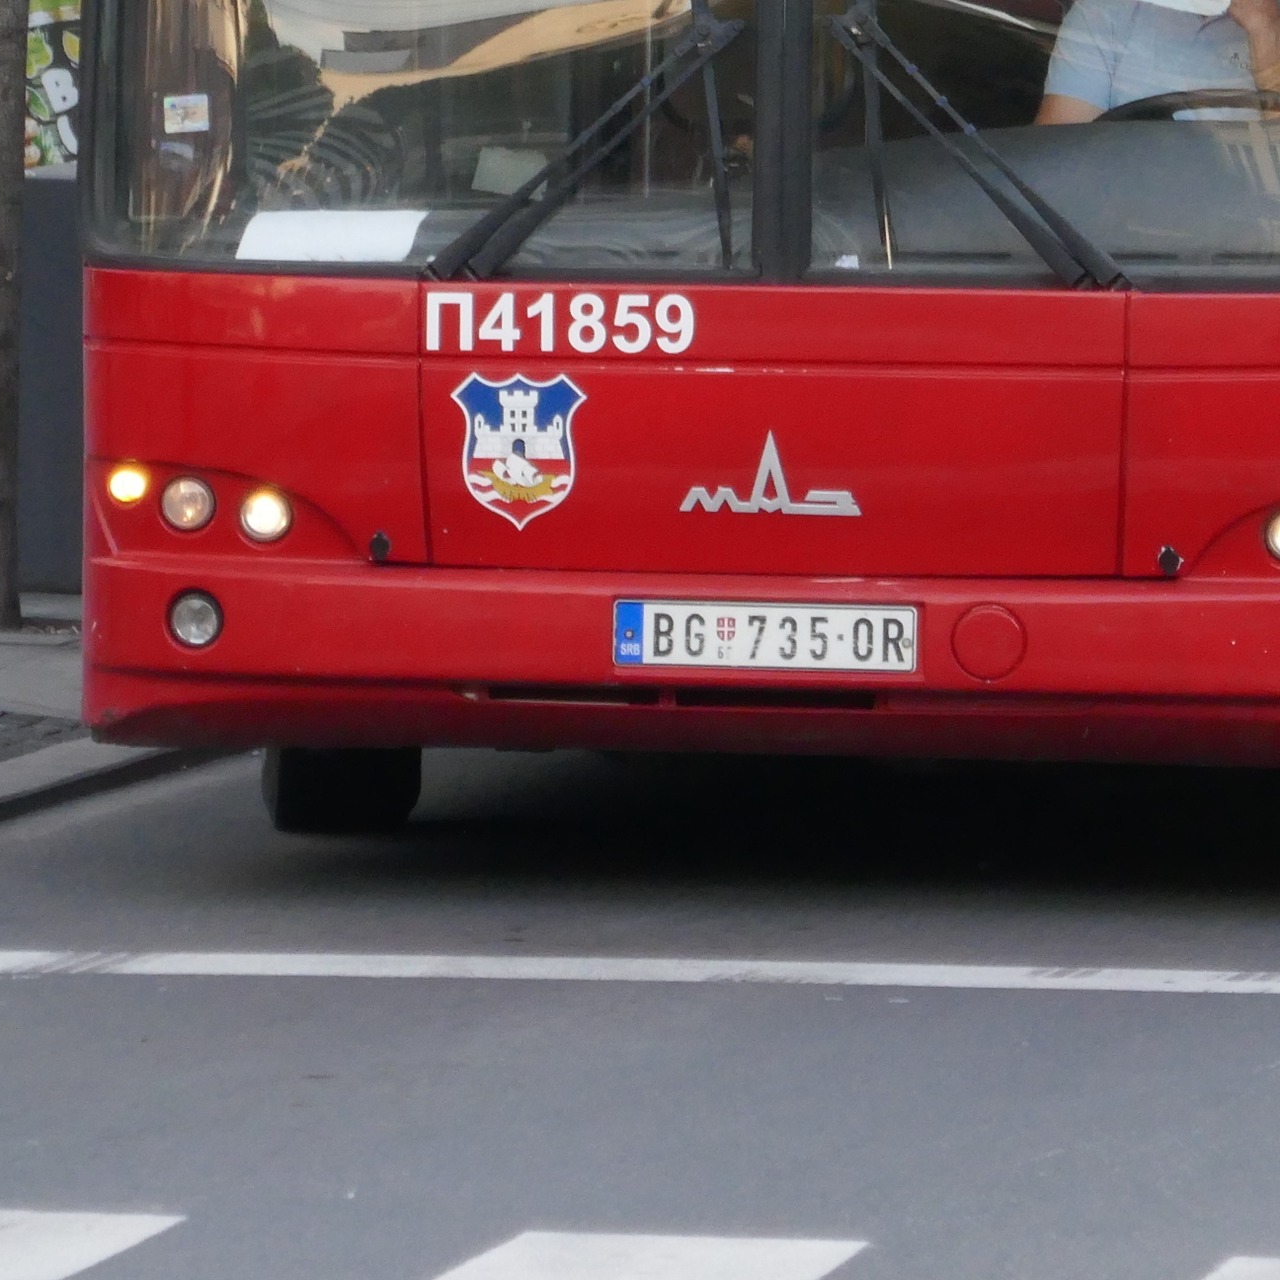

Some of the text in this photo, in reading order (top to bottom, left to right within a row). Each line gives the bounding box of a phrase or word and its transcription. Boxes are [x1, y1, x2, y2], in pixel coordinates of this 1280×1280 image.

[425, 291, 696, 355] П41859
[619, 642, 641, 656] SRB
[652, 612, 706, 659] BG
